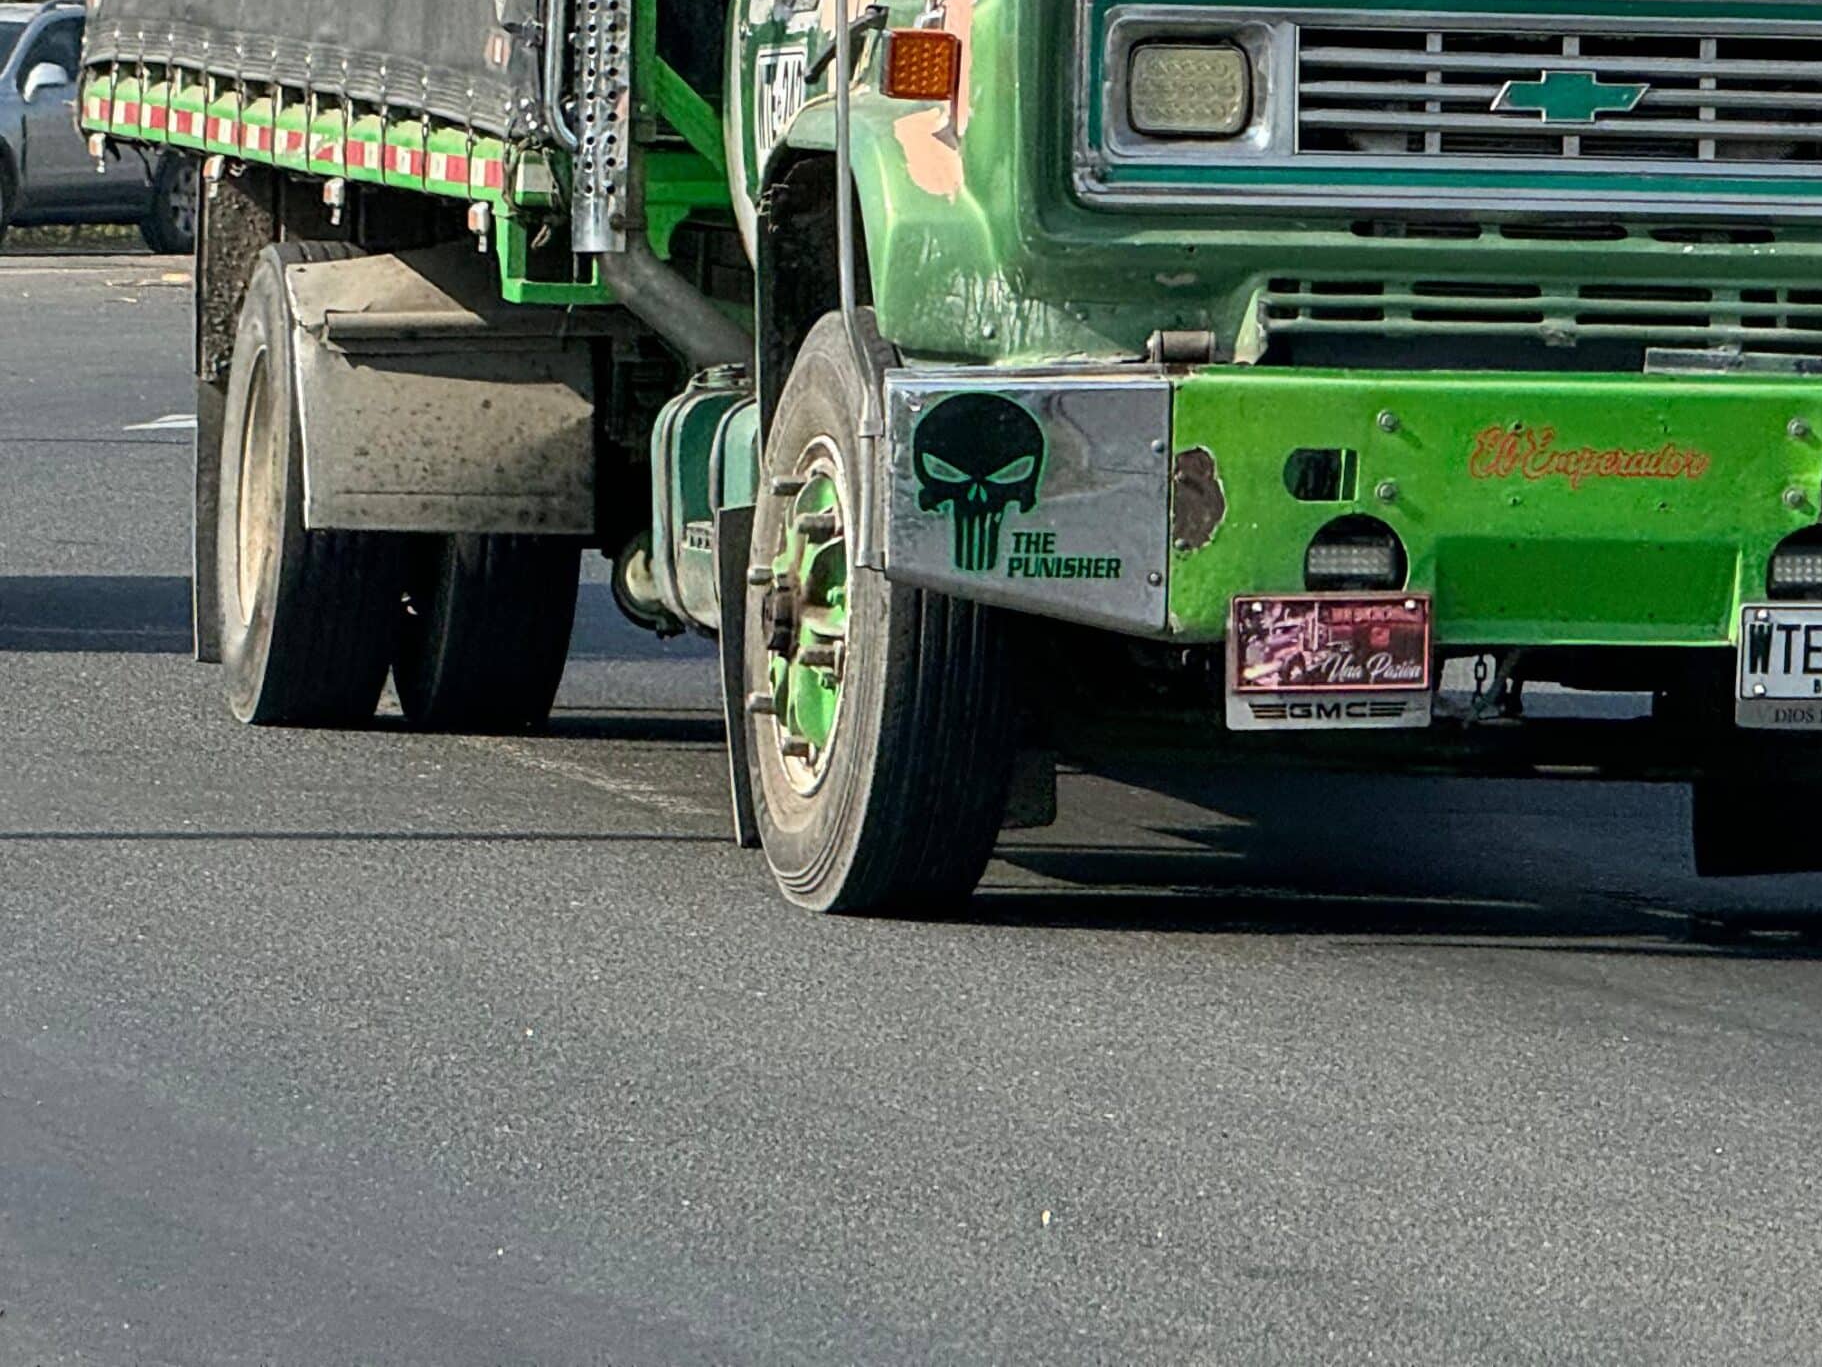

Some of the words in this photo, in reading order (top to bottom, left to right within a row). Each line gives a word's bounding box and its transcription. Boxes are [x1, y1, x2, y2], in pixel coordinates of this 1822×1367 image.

[1470, 427, 1516, 479] El
[1522, 427, 1709, 490] Emperador
[1011, 532, 1056, 554] THE
[1007, 557, 1121, 579] PUNISHER
[1289, 703, 1367, 719] GMC
[1774, 708, 1814, 723] DIOS
